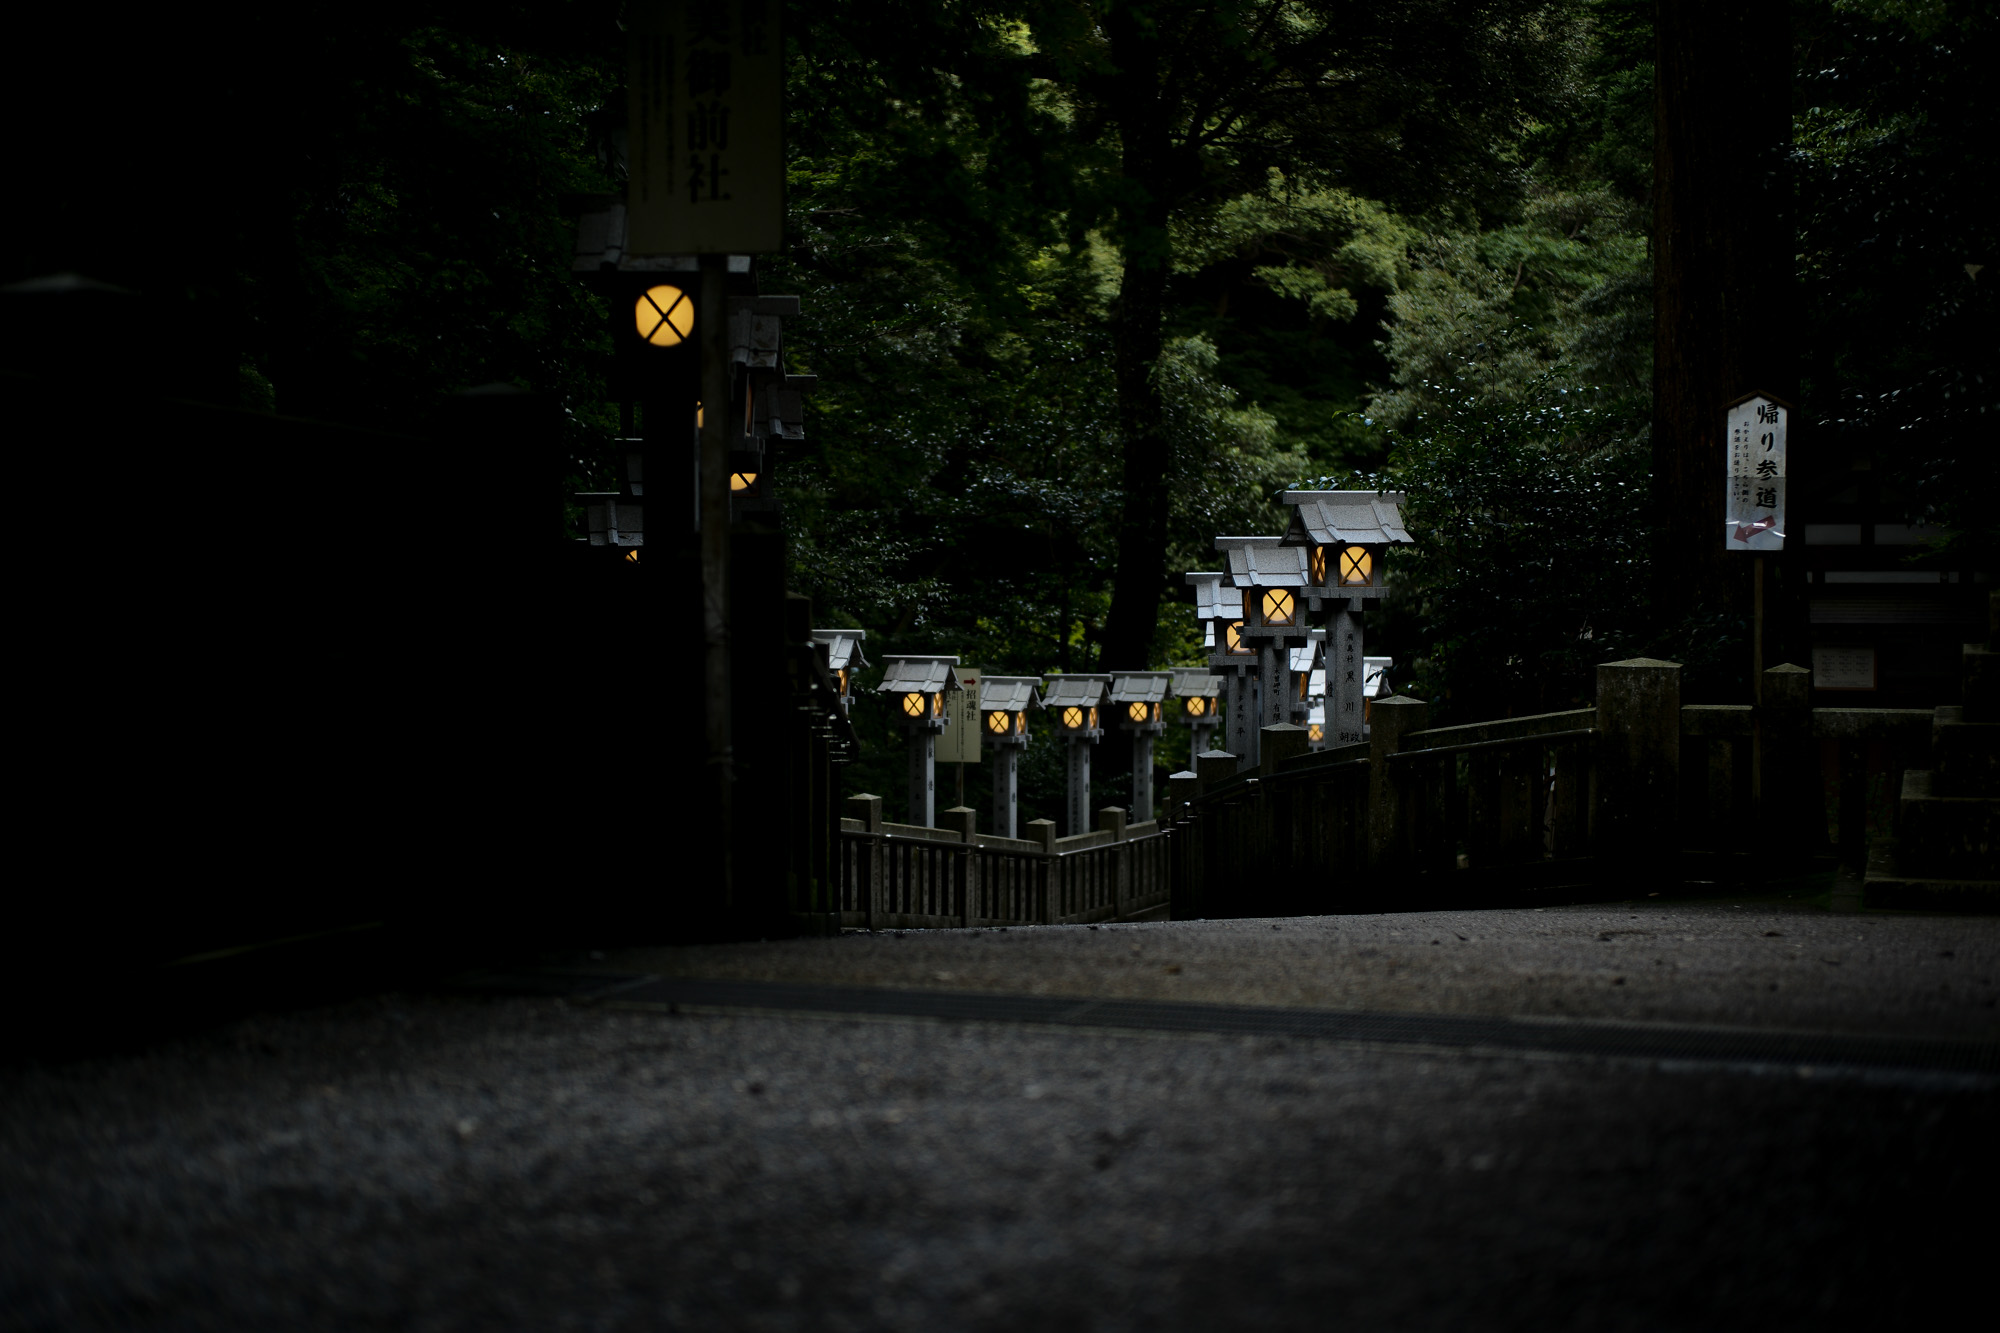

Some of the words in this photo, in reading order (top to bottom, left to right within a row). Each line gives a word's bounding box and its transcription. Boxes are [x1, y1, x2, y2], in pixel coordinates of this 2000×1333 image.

[1756, 402, 1780, 509] 帰り参道
[966, 689, 977, 721] 招魂社
